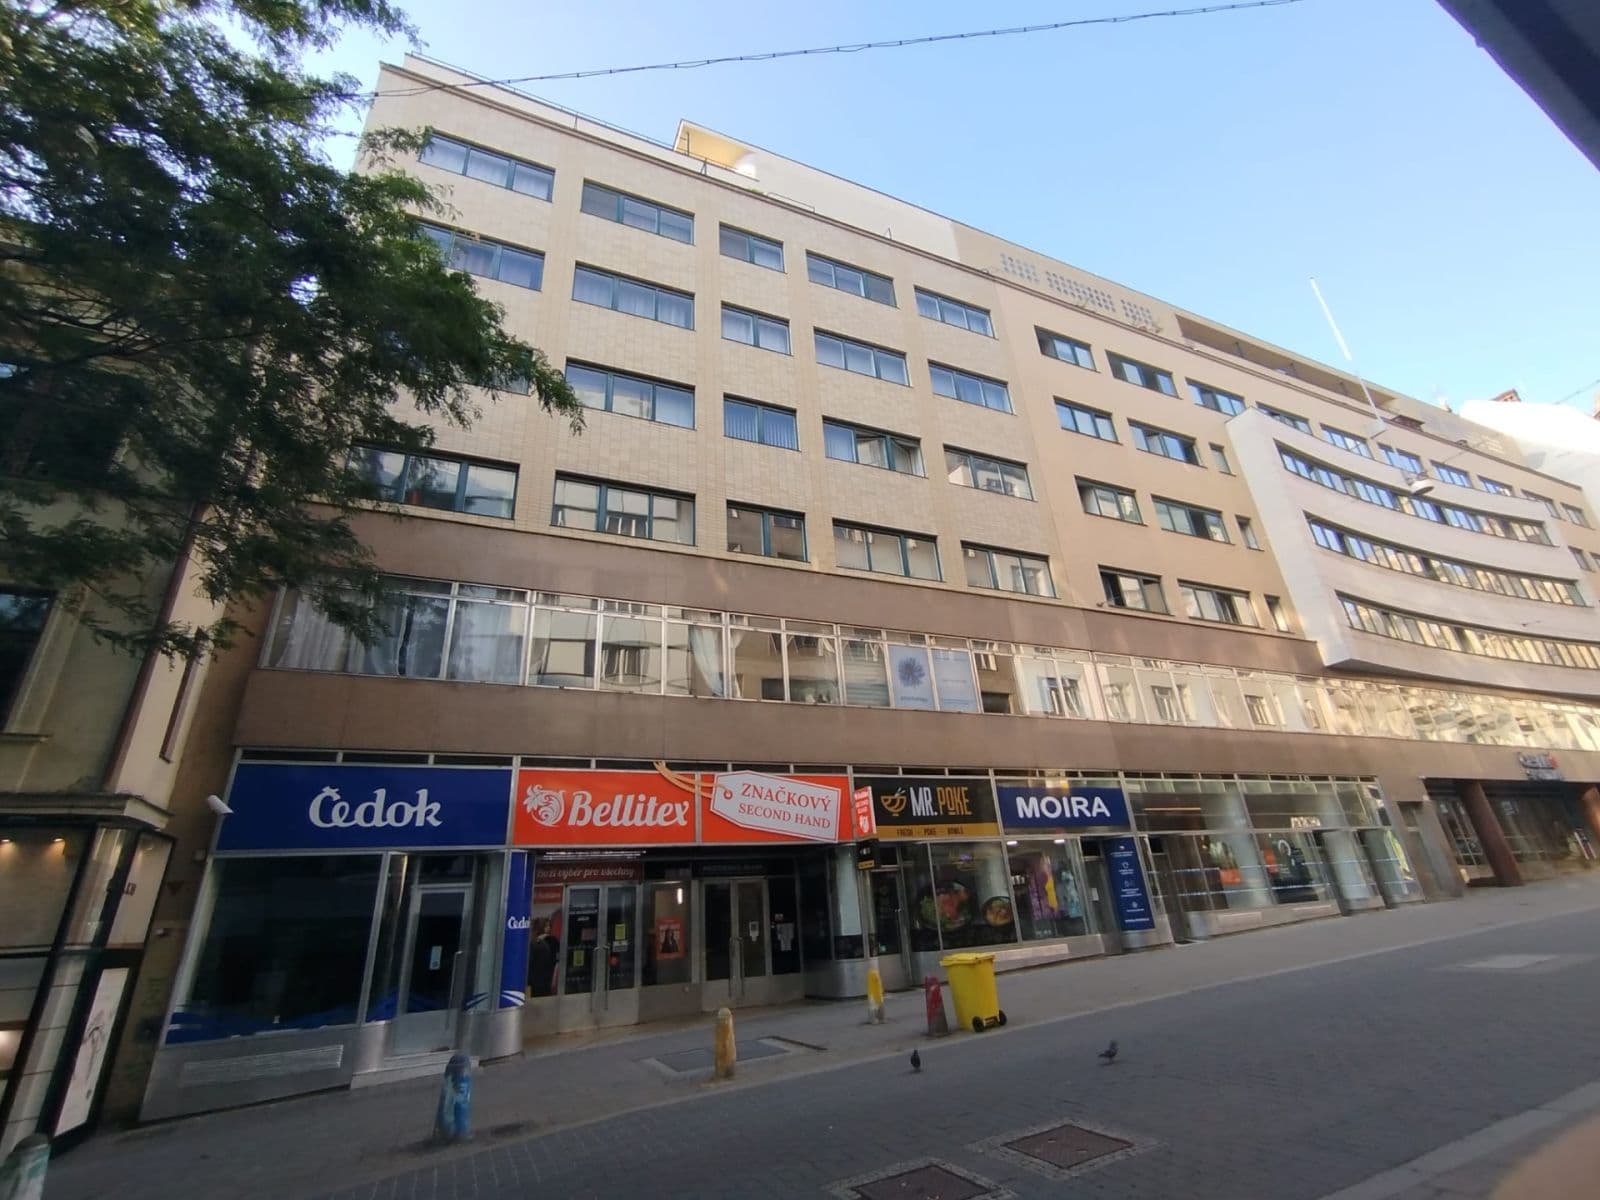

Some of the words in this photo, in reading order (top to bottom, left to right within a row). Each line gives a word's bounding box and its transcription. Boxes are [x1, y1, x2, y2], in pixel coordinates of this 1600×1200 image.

[308, 786, 443, 828] Čedok
[568, 790, 690, 828] Bellitex
[741, 782, 832, 813] ZNAČKOVÝ
[909, 786, 938, 817] MR.
[938, 786, 973, 816] POKE
[1016, 796, 1111, 820] MOIRA
[738, 803, 791, 823] SECOND
[794, 812, 831, 830] HAND
